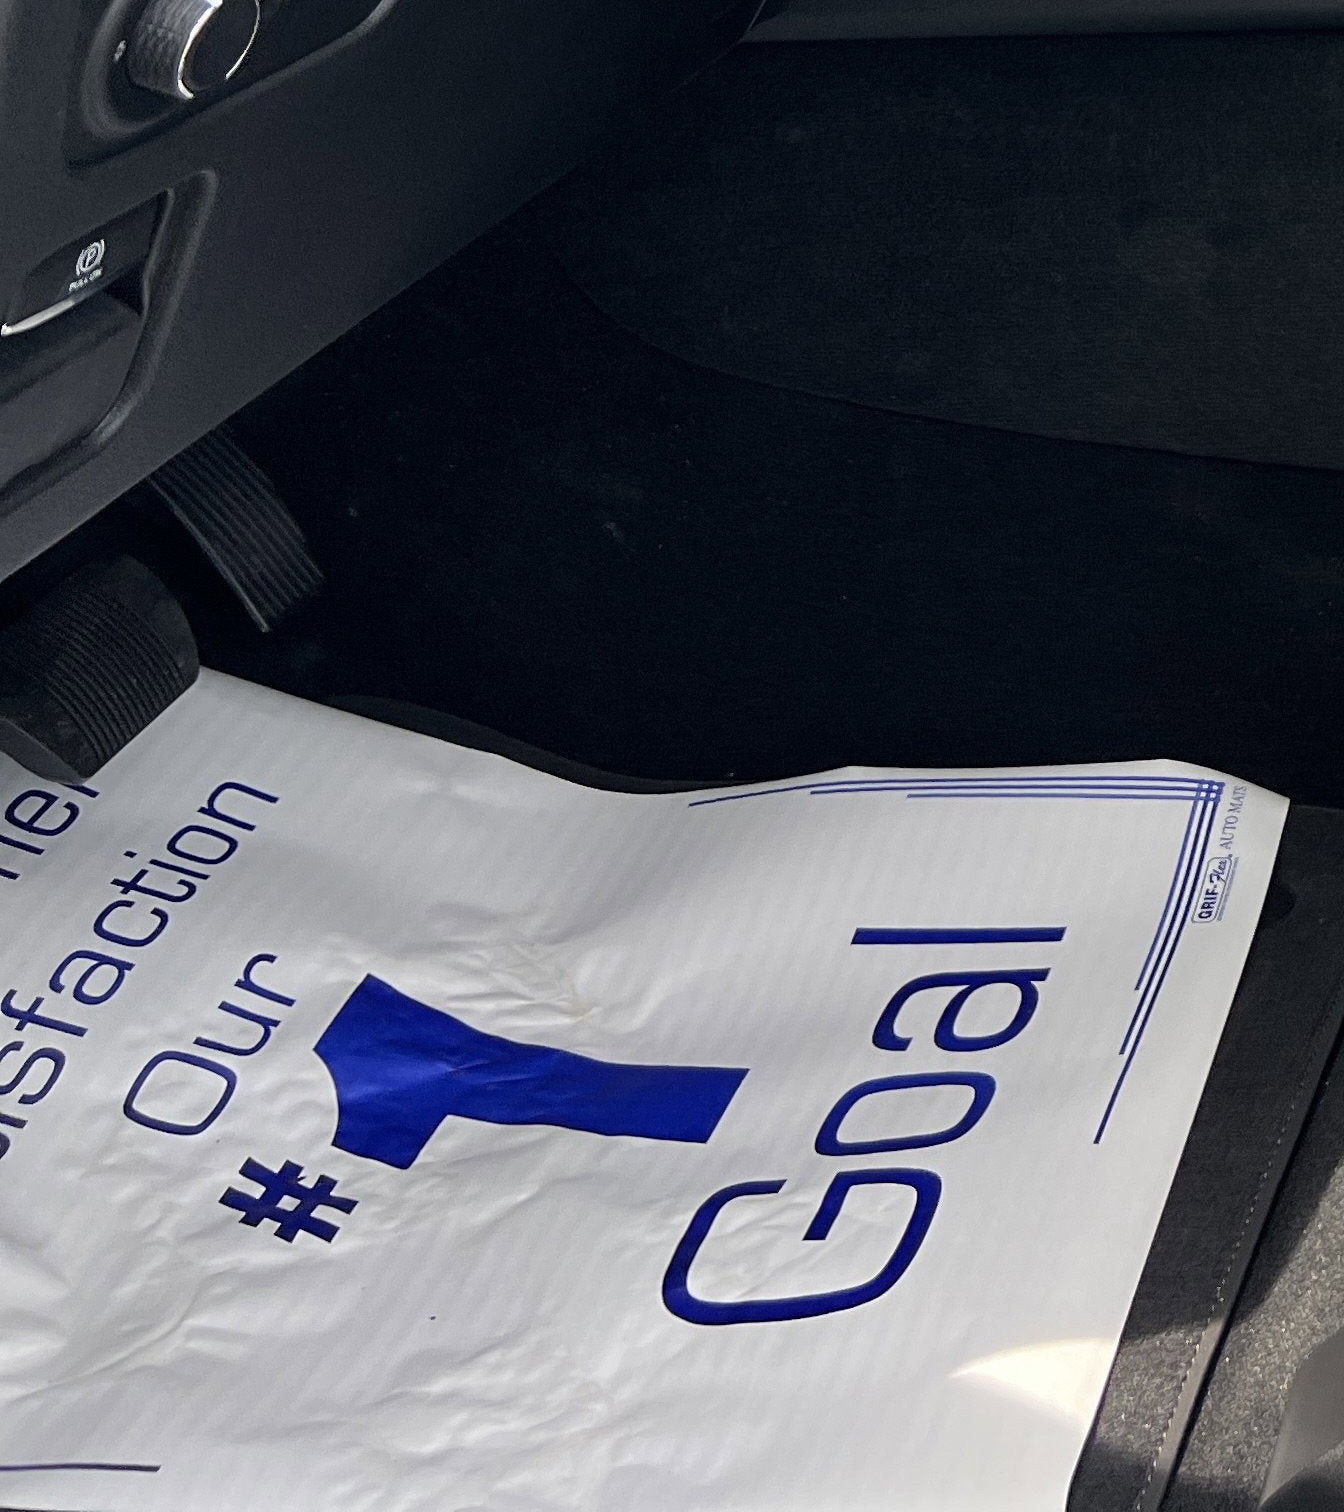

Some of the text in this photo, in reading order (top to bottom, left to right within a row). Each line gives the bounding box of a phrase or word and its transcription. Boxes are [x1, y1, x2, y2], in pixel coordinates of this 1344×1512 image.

[1220, 815, 1239, 850] AUTO
[123, 952, 297, 1136] Our
[660, 925, 1067, 1326] Goal
